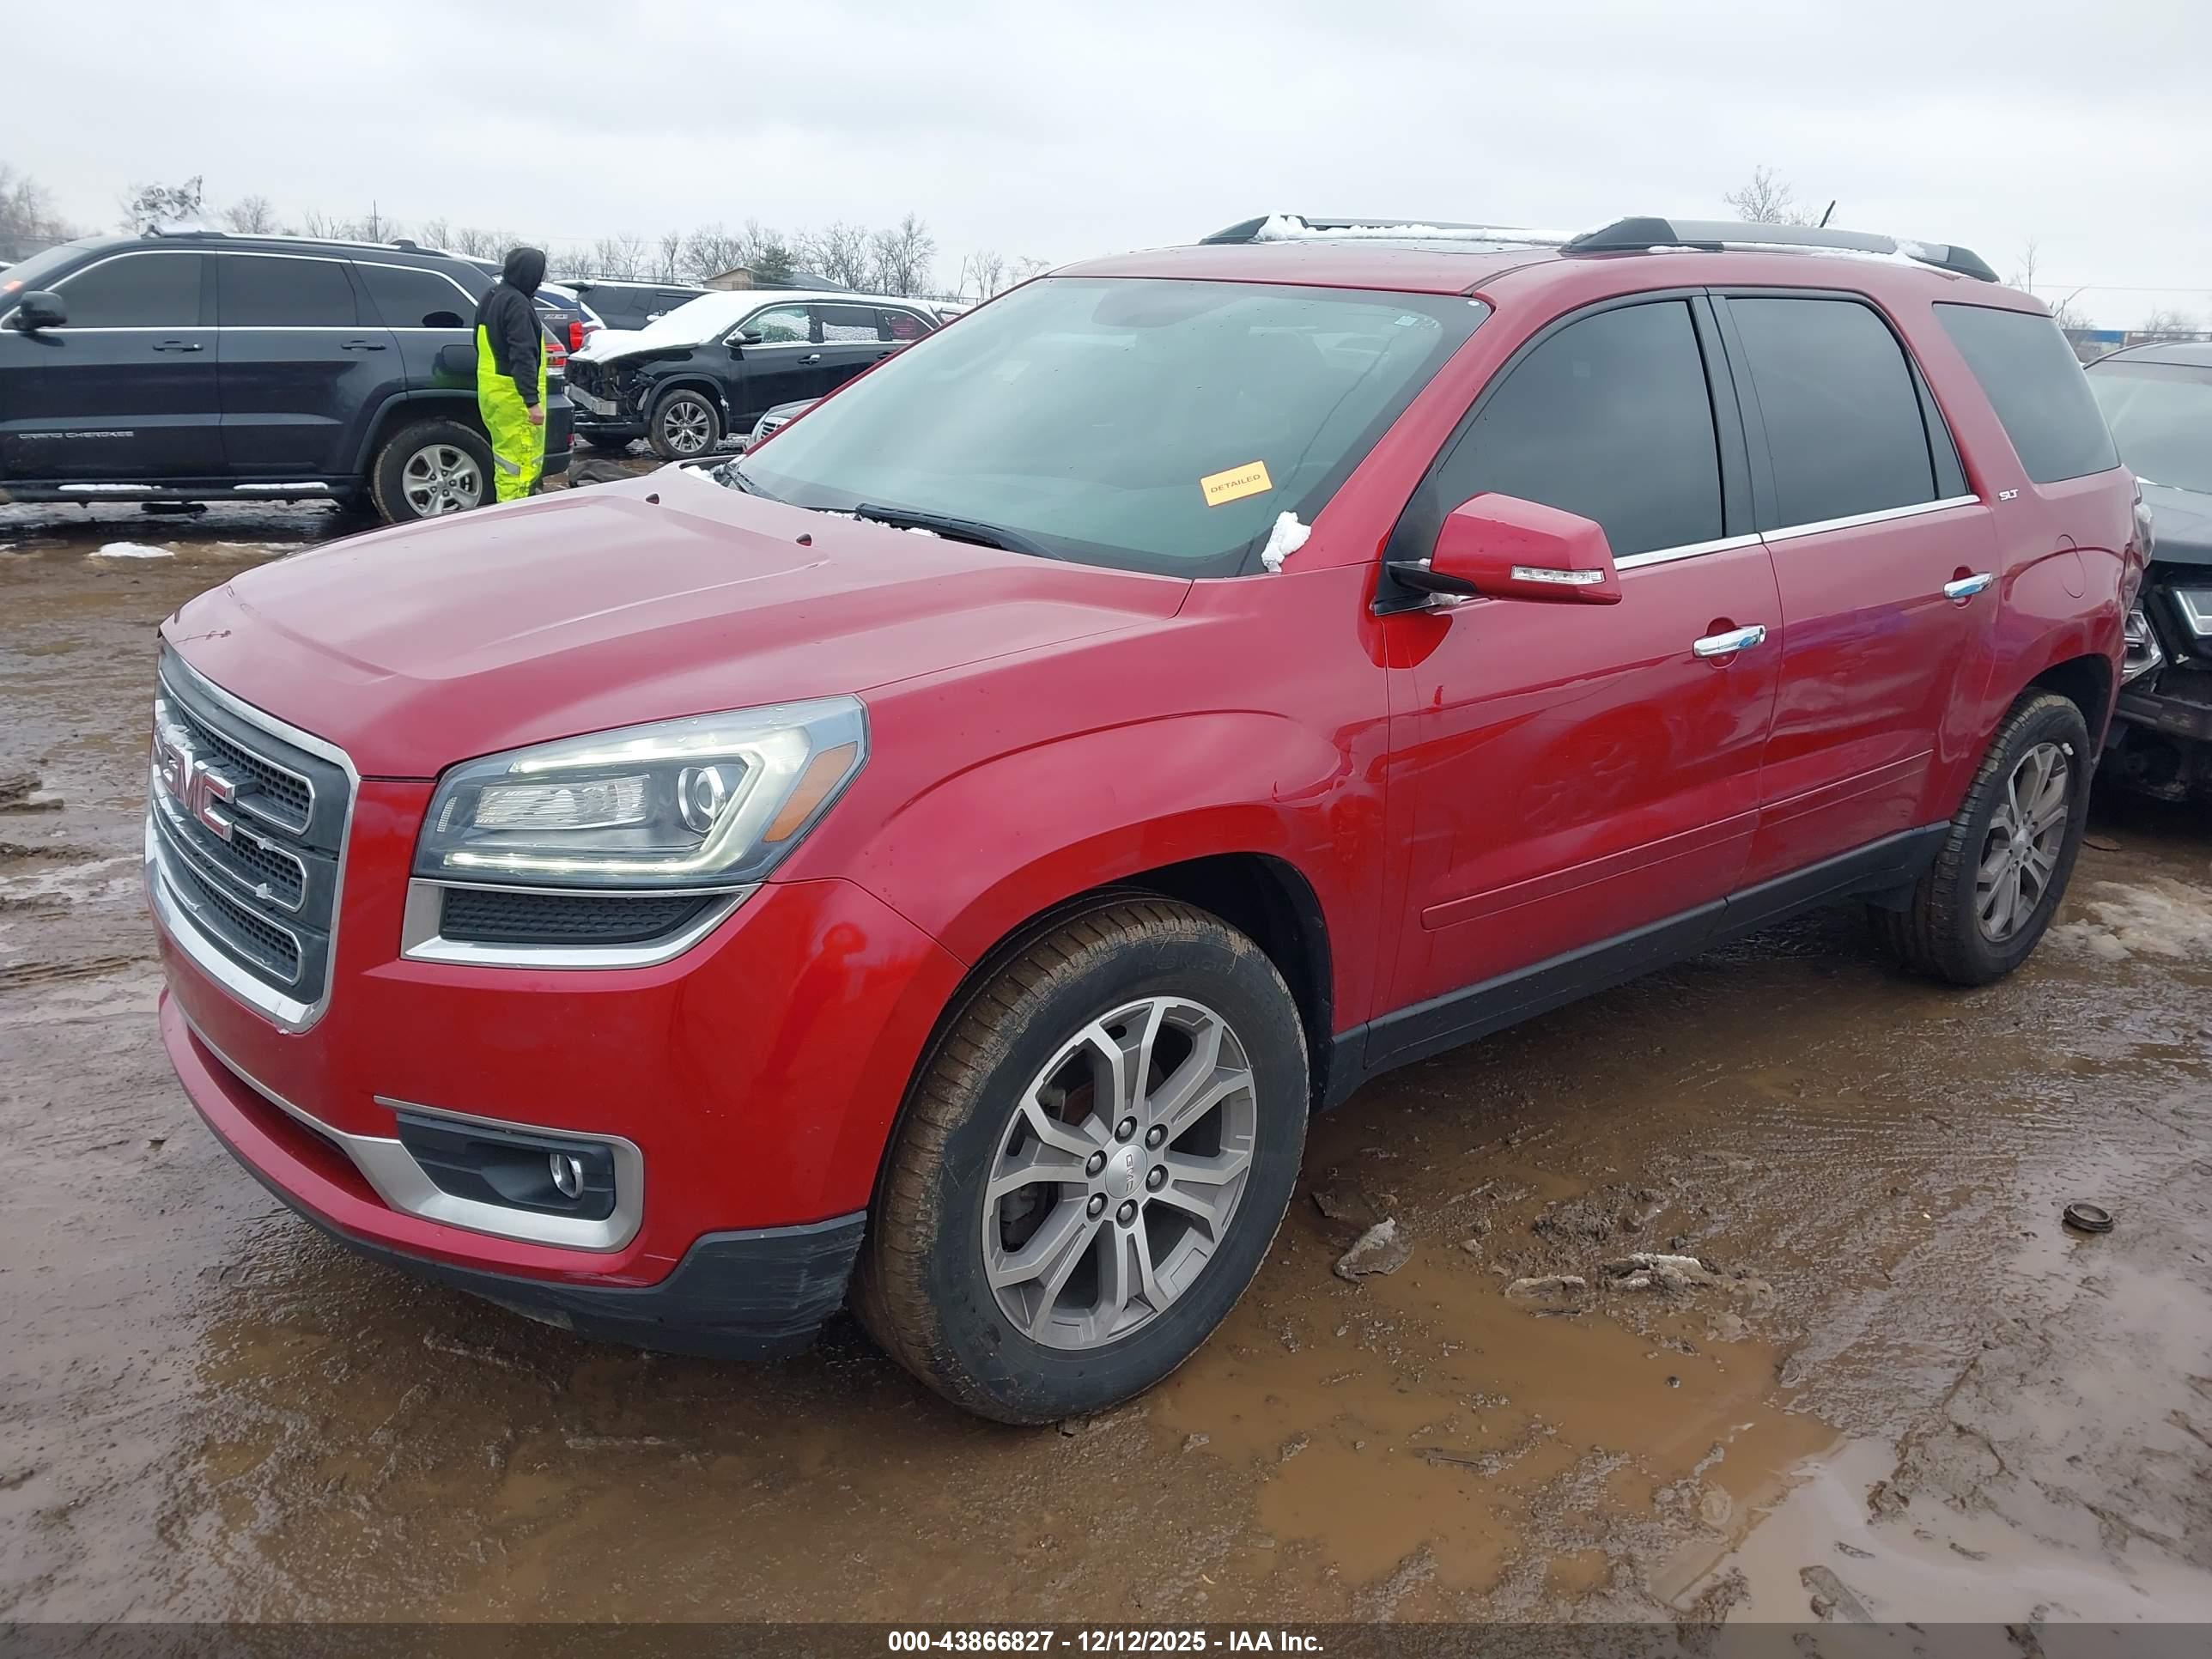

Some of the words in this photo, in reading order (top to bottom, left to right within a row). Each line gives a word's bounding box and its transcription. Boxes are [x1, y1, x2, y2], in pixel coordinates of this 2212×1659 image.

[1210, 474, 1261, 493] DETAILED
[1999, 489, 2019, 501] SLT
[160, 733, 235, 842] GMC
[1124, 1153, 1134, 1192] GMC
